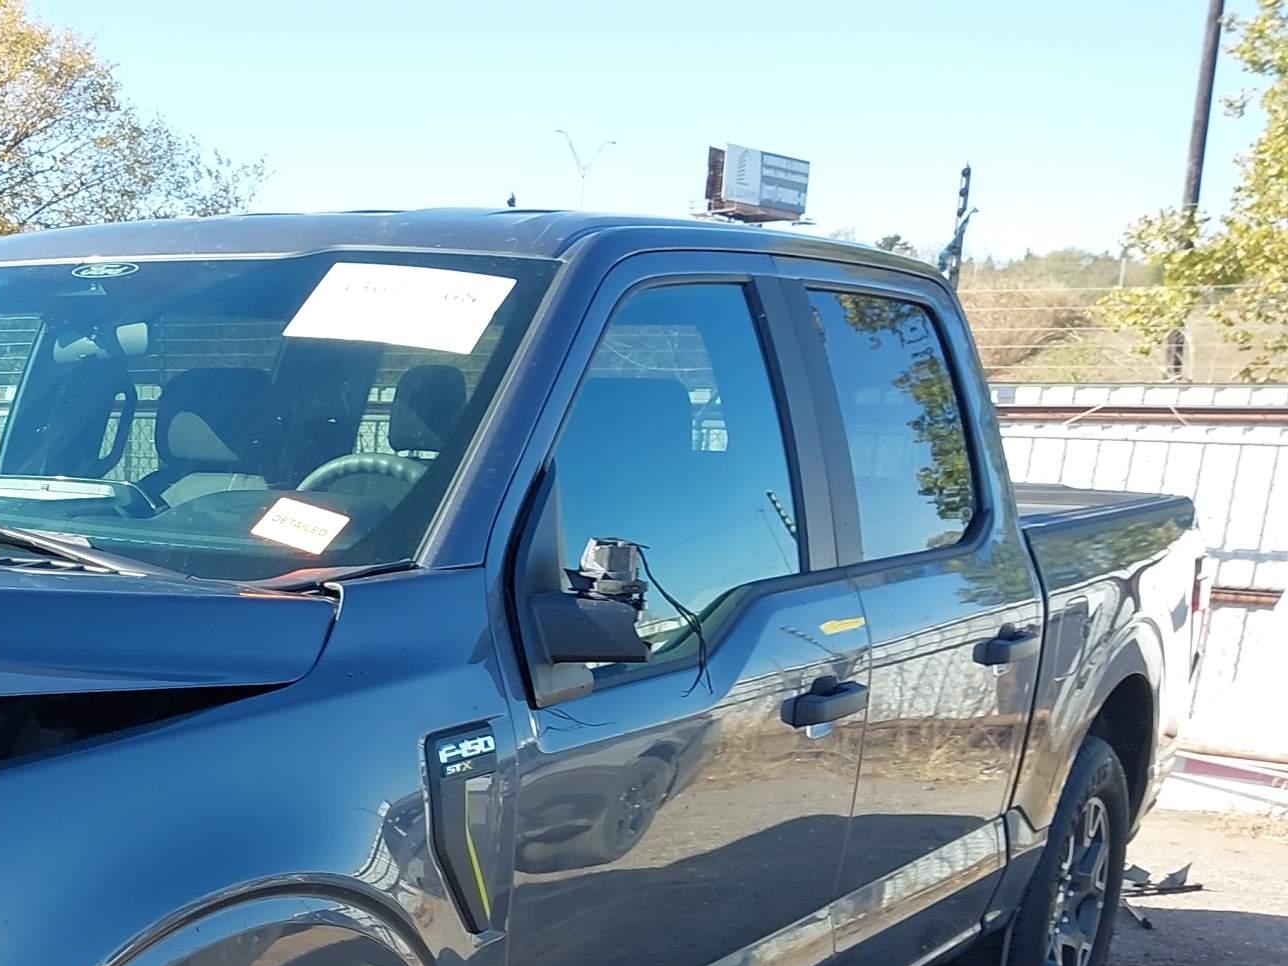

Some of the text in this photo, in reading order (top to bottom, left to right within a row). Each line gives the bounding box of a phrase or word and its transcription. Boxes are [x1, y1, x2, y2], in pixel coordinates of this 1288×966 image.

[271, 514, 328, 537] DETAILED
[438, 735, 496, 764] F-150
[446, 759, 473, 775] STX
